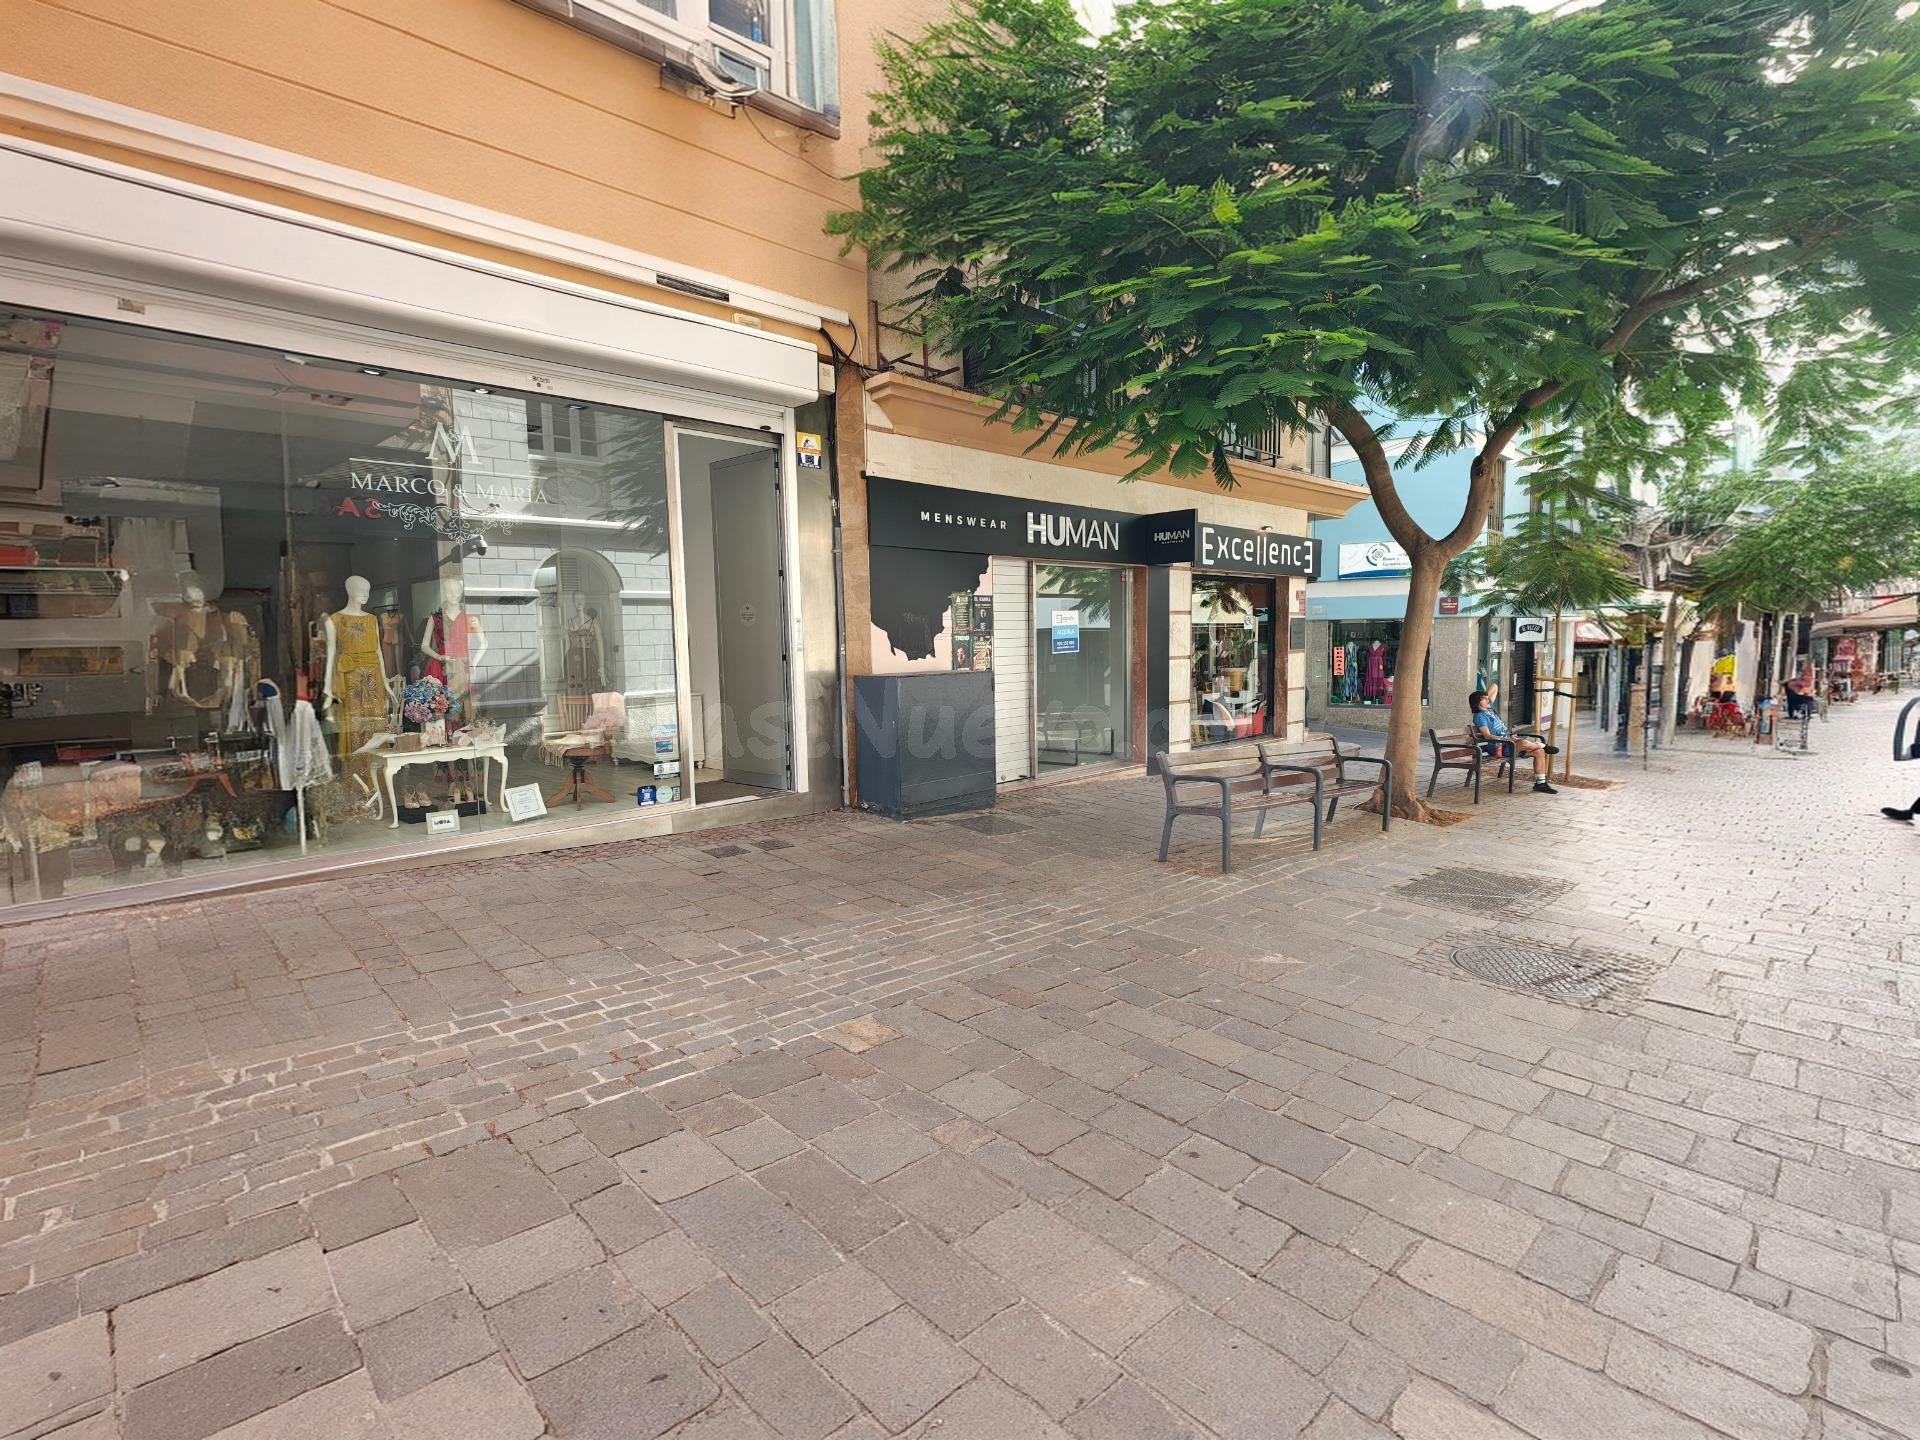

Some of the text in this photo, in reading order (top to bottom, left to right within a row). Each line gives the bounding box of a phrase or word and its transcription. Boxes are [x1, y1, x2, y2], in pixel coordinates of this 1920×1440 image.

[350, 472, 446, 496] MARCO
[452, 484, 468, 499] &
[921, 511, 1119, 551] MENSWEAR HUMAN
[1154, 529, 1190, 542] HUMAN
